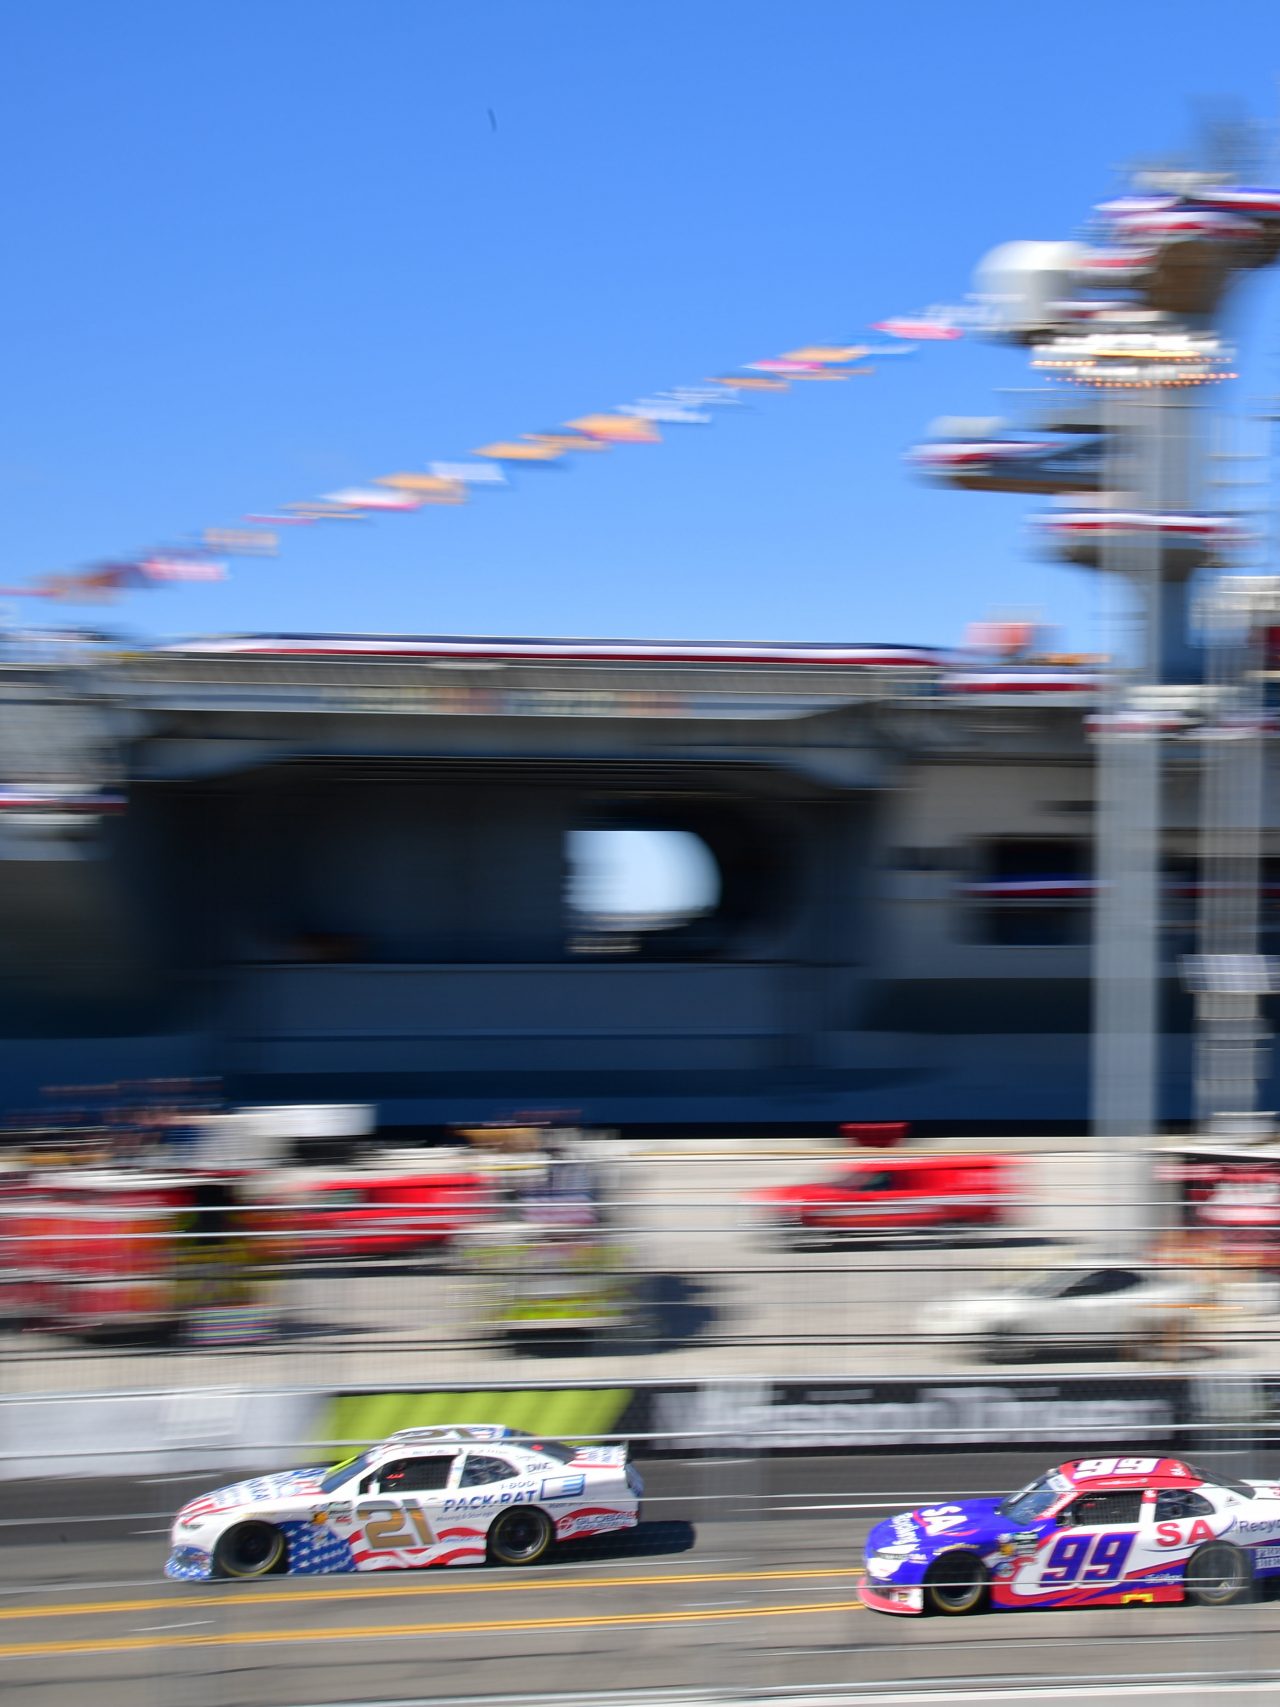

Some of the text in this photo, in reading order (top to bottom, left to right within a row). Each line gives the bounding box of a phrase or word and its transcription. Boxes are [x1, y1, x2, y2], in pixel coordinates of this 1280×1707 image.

[1071, 1458, 1160, 1480] 99
[356, 1499, 436, 1549] 21
[920, 1506, 968, 1537] SA
[1156, 1520, 1216, 1547] SA
[1039, 1531, 1139, 1588] 99
